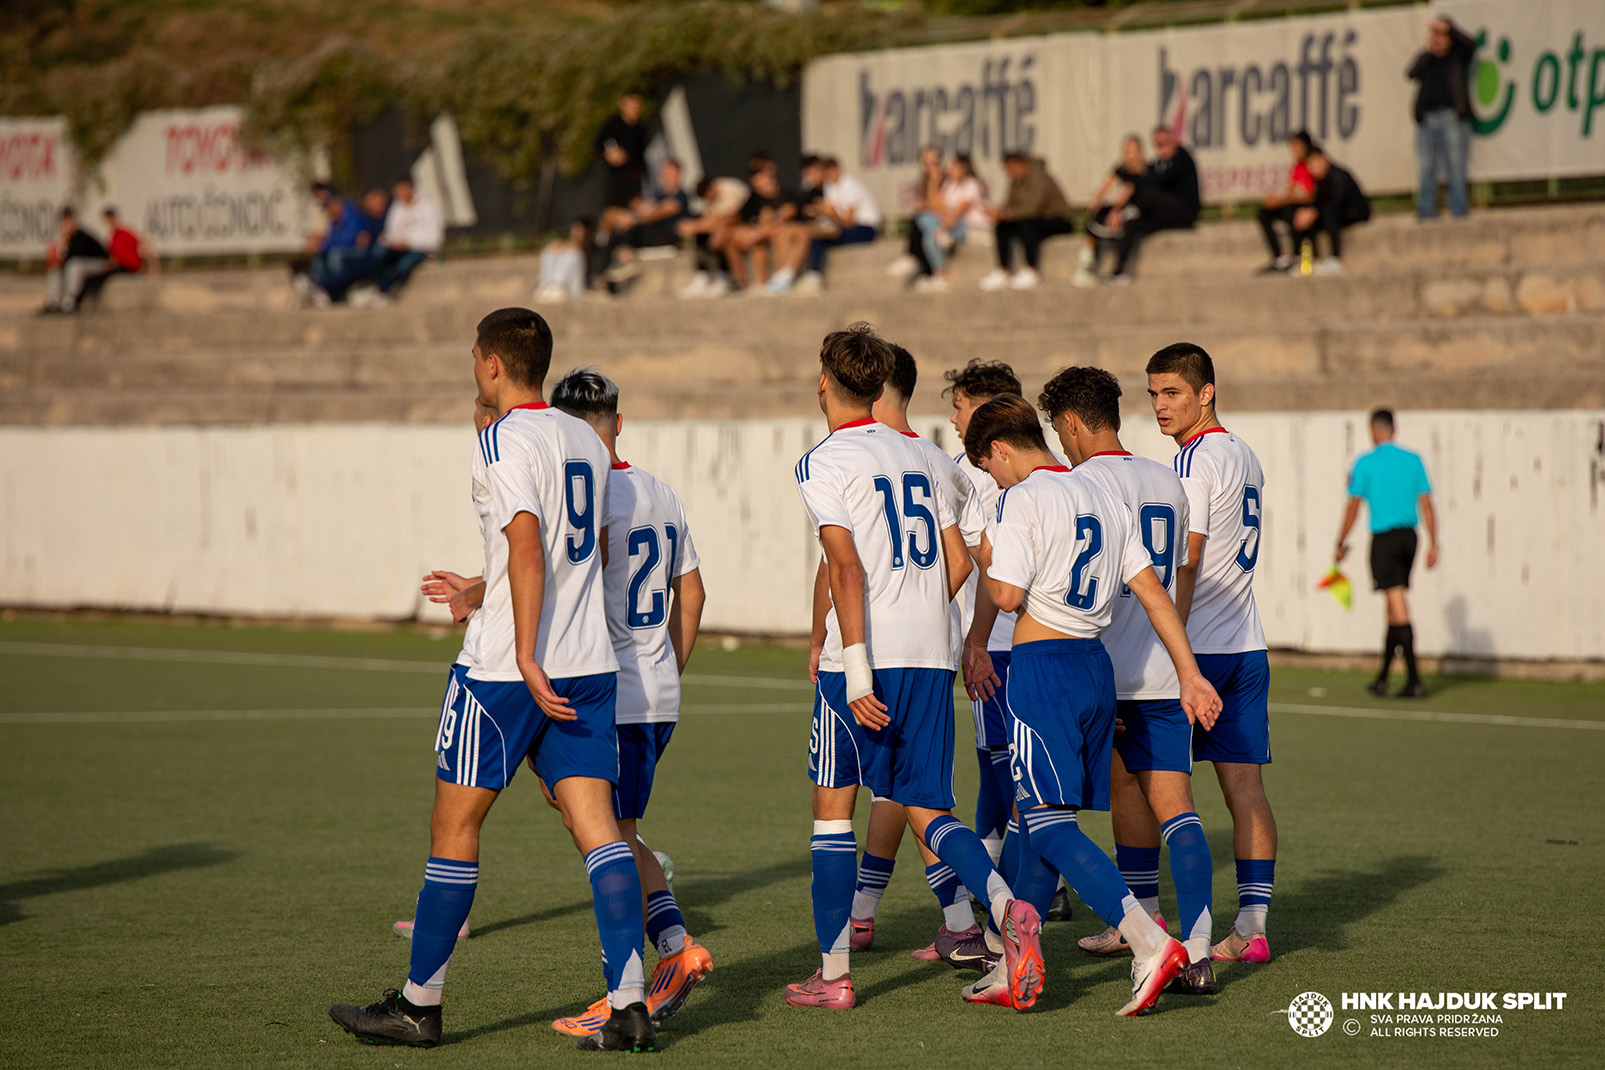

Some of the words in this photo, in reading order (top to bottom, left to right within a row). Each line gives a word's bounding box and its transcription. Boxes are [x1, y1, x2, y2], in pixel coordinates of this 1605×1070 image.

[1157, 28, 1360, 148] barcaffé
[562, 458, 598, 566] 9
[872, 471, 939, 571] 15
[1234, 484, 1263, 574] 5
[626, 522, 679, 631] 21
[1064, 513, 1105, 611] 2
[441, 708, 457, 750] 9
[1008, 742, 1022, 782] 2
